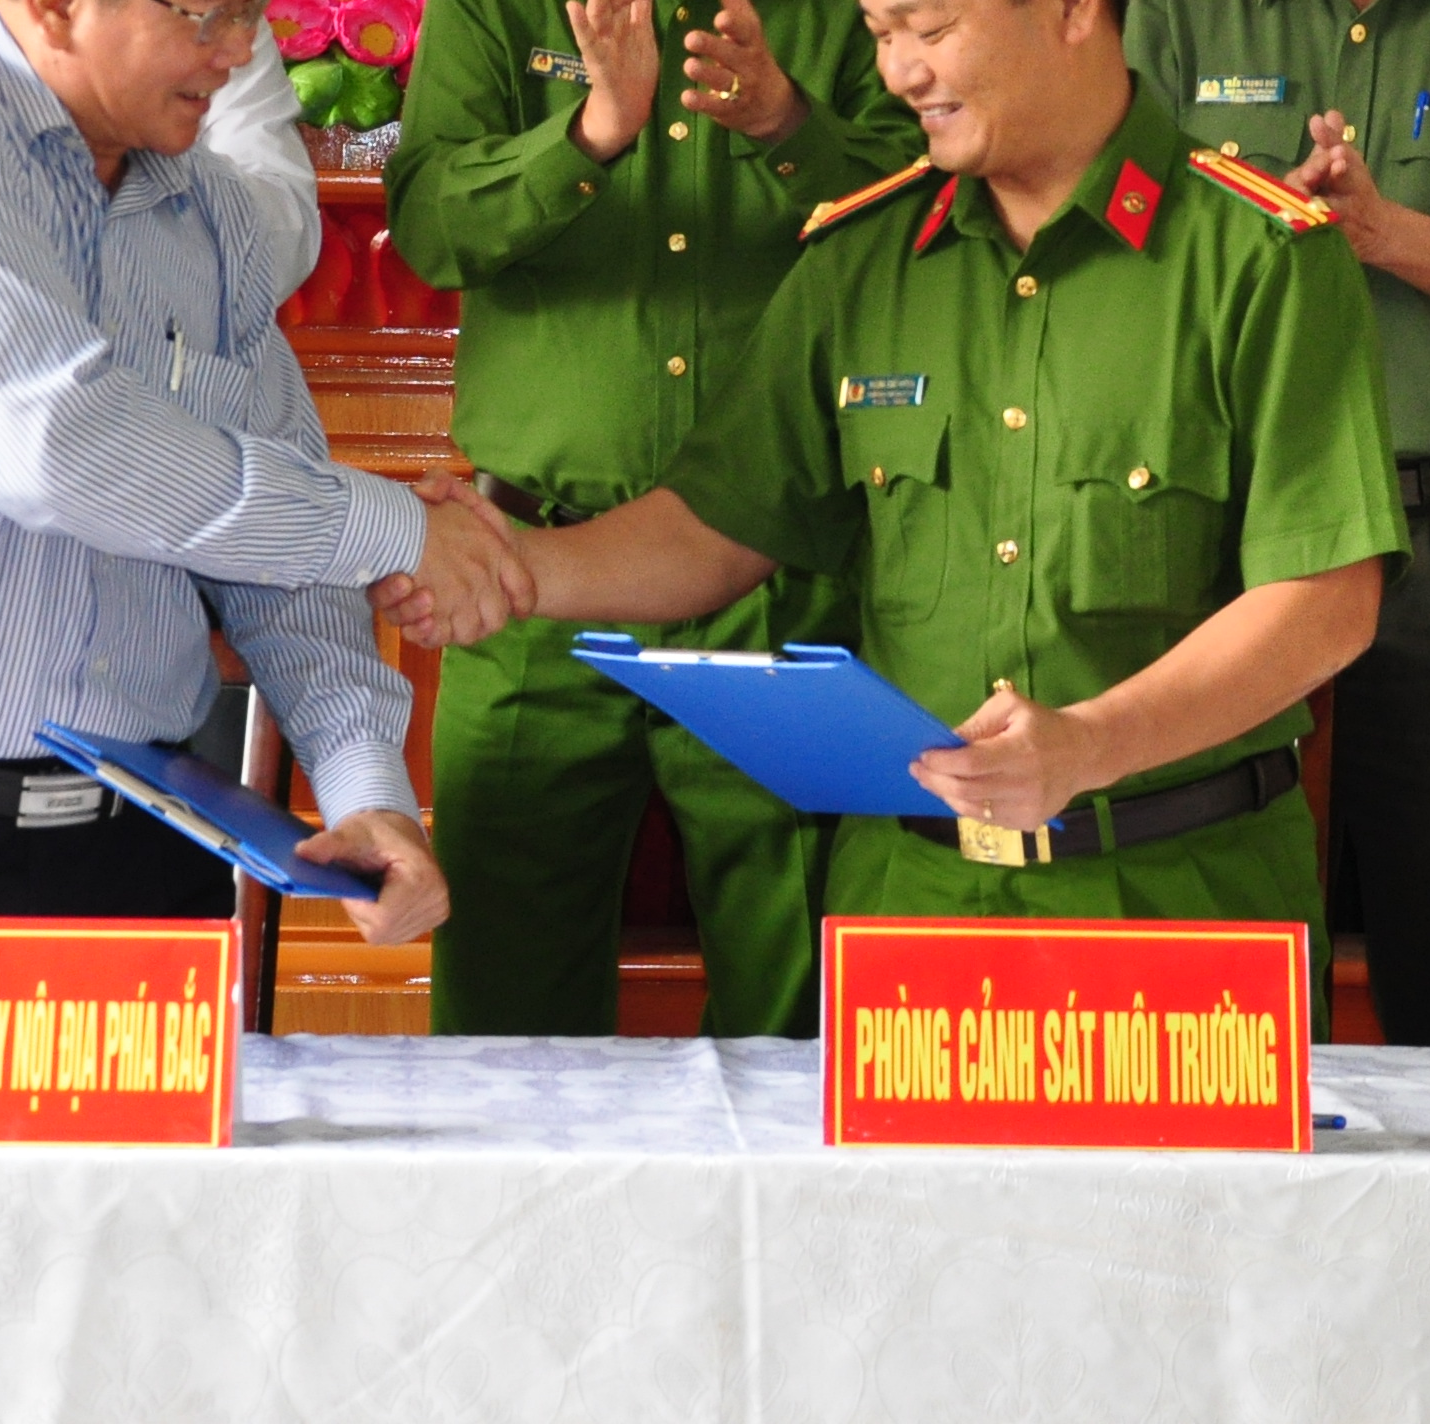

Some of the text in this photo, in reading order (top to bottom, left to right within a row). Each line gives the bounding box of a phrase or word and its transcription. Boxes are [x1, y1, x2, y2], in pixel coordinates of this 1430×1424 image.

[9, 980, 57, 1113] NỘI
[56, 999, 99, 1113] ĐỊA
[101, 981, 159, 1092] PHÍA
[161, 967, 212, 1093] BẮC
[855, 978, 1278, 1106] PHÒNG CẢNH SÁT MÔI TRƯỜNG
